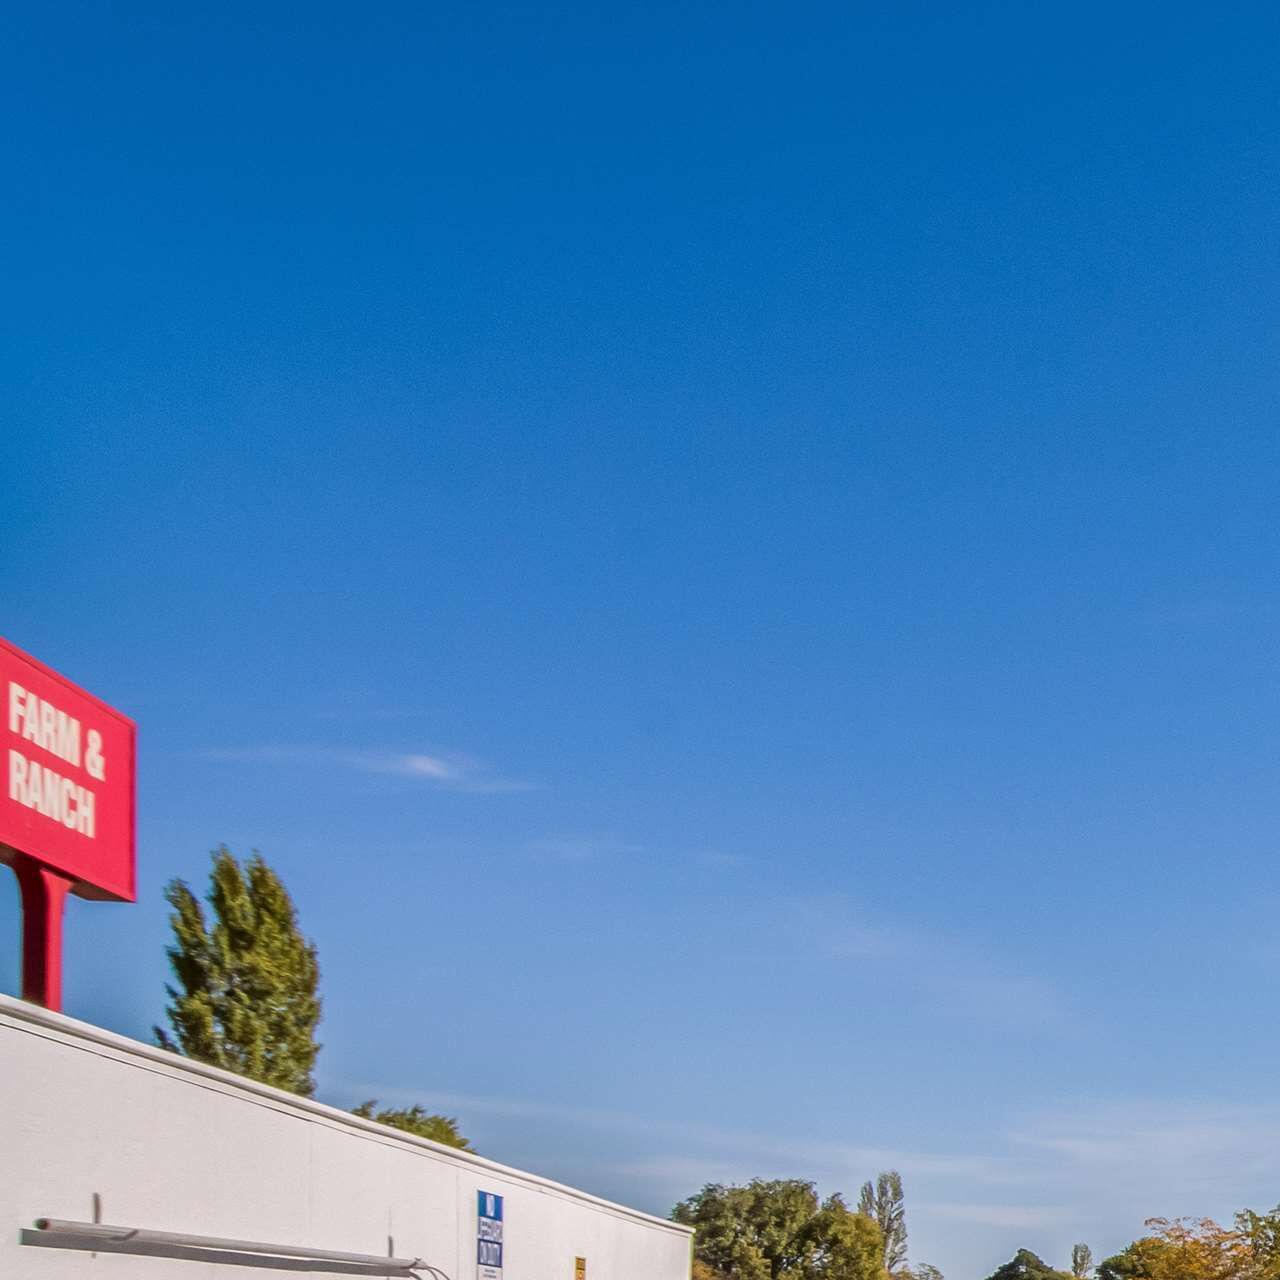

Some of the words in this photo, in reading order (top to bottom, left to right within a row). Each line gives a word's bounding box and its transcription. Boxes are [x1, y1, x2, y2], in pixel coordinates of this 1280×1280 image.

[8, 681, 81, 767] FARM
[85, 729, 106, 781] &
[8, 749, 96, 838] RANCH
